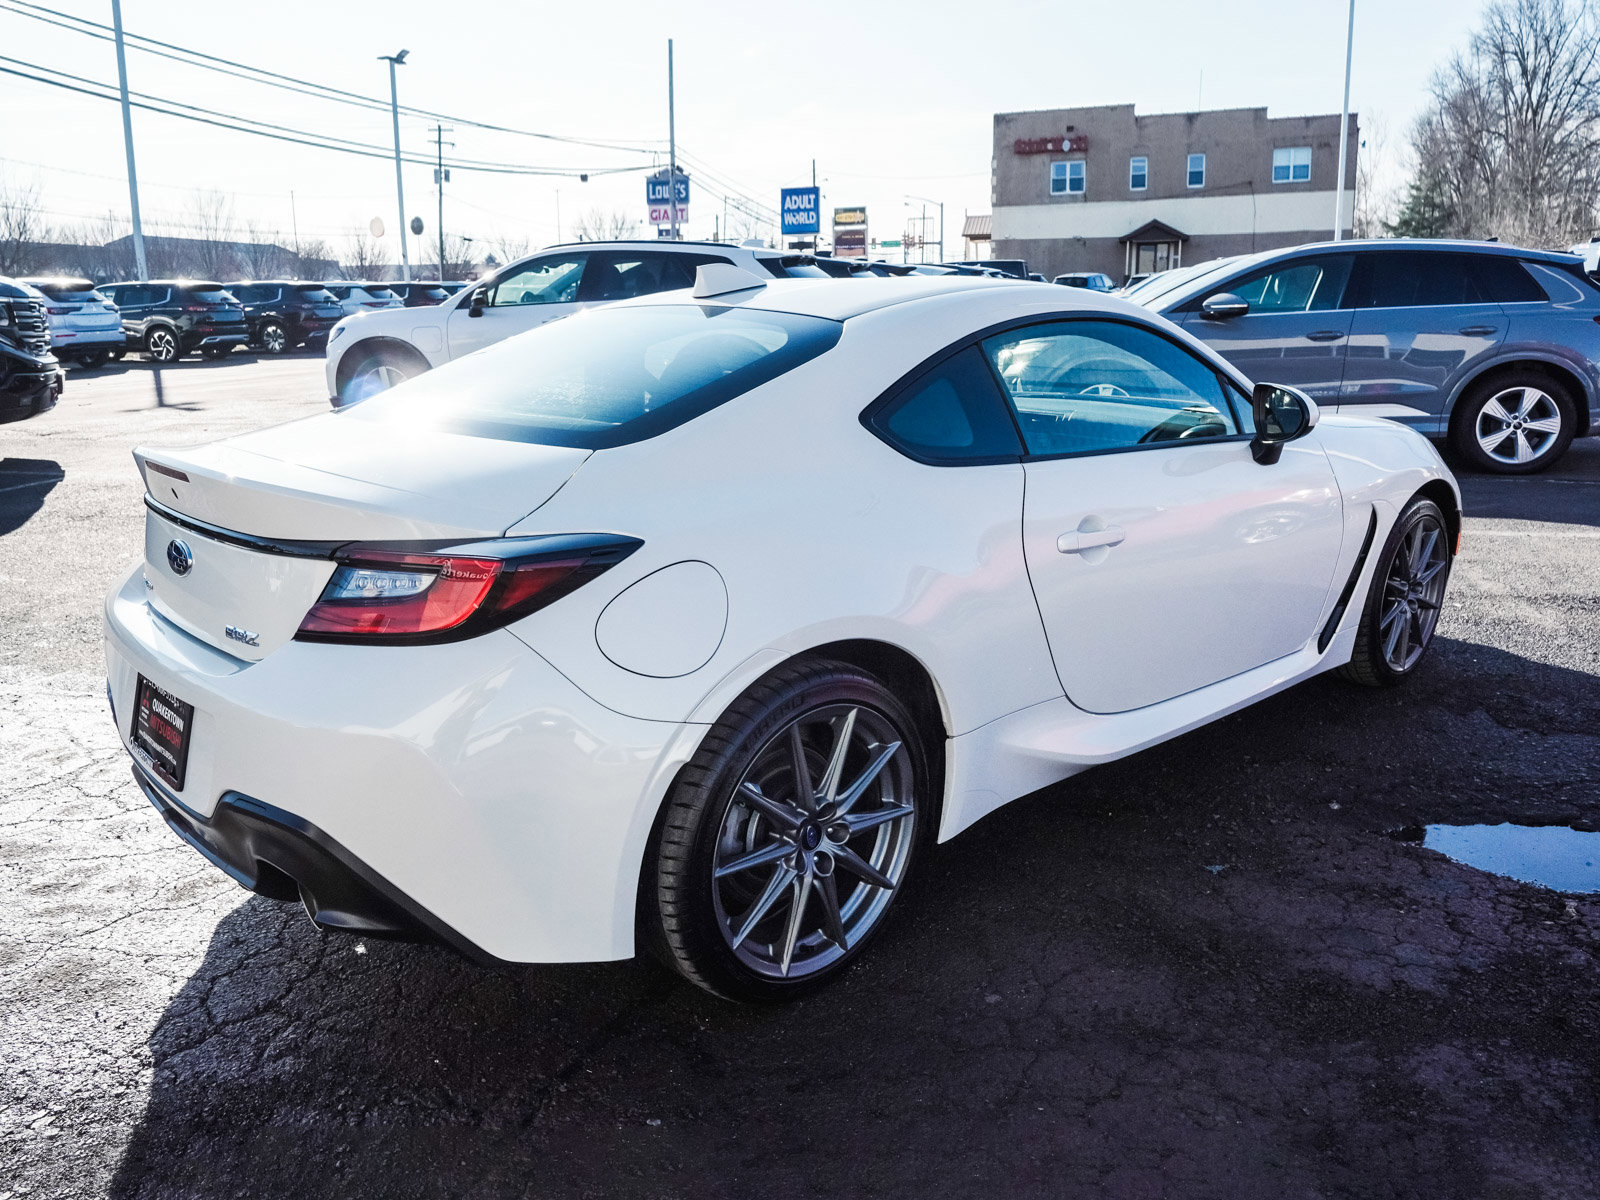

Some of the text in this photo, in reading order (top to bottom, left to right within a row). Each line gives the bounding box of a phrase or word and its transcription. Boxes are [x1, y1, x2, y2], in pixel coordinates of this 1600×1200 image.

[784, 194, 815, 210] ADULT
[784, 211, 816, 226] WORLD
[152, 698, 184, 732] QUAKERTOWN
[150, 713, 182, 749] MITSUBISHI
